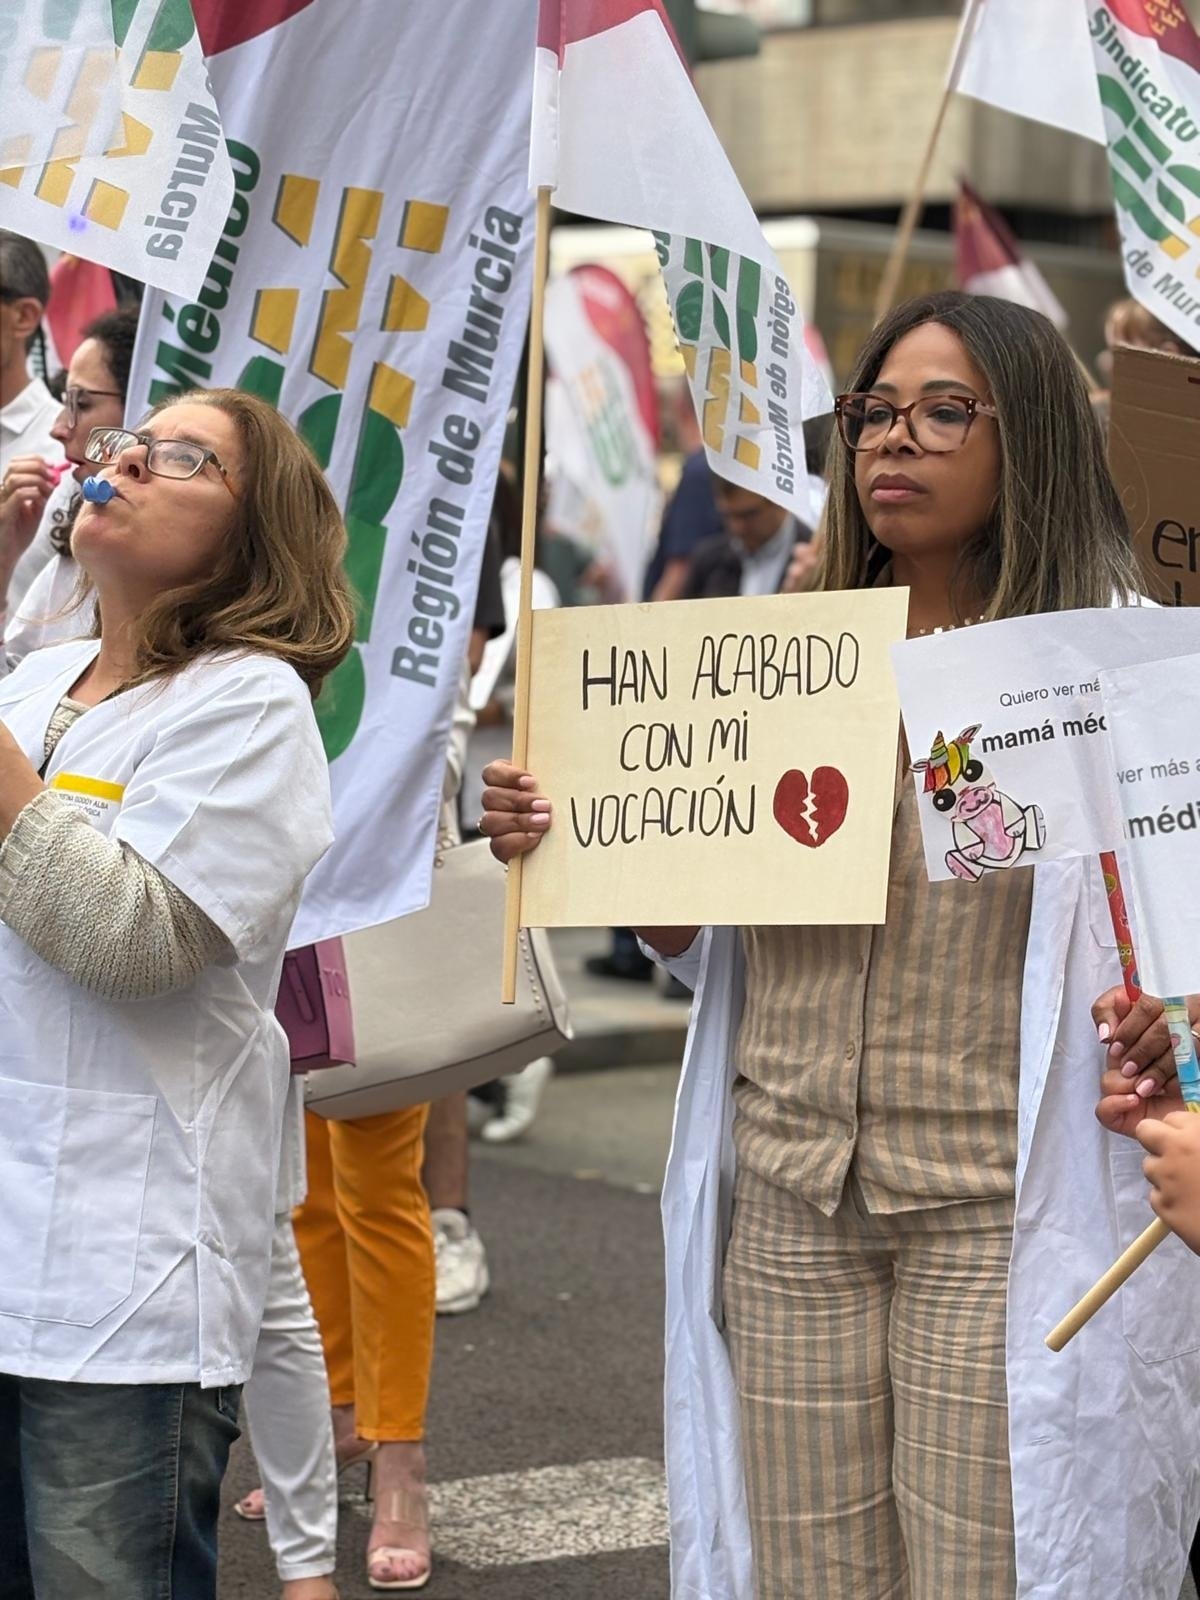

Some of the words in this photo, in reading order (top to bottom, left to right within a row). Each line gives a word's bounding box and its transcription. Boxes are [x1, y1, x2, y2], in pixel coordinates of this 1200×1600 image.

[1088, 7, 1199, 142] Sindicato
[441, 204, 525, 403] Murcia
[1126, 249, 1154, 278] de
[1153, 273, 1200, 326] Mur
[428, 413, 481, 485] de
[390, 496, 467, 688] Región
[582, 645, 669, 710] HAN
[691, 632, 860, 700] ACABADO
[999, 688, 1049, 707] Quiero
[1052, 685, 1075, 697] ver
[619, 723, 693, 771] CON
[981, 718, 1055, 753] mamá
[1116, 767, 1144, 784] ver
[1150, 758, 1190, 779] más
[570, 774, 756, 848] VOCACIÓN
